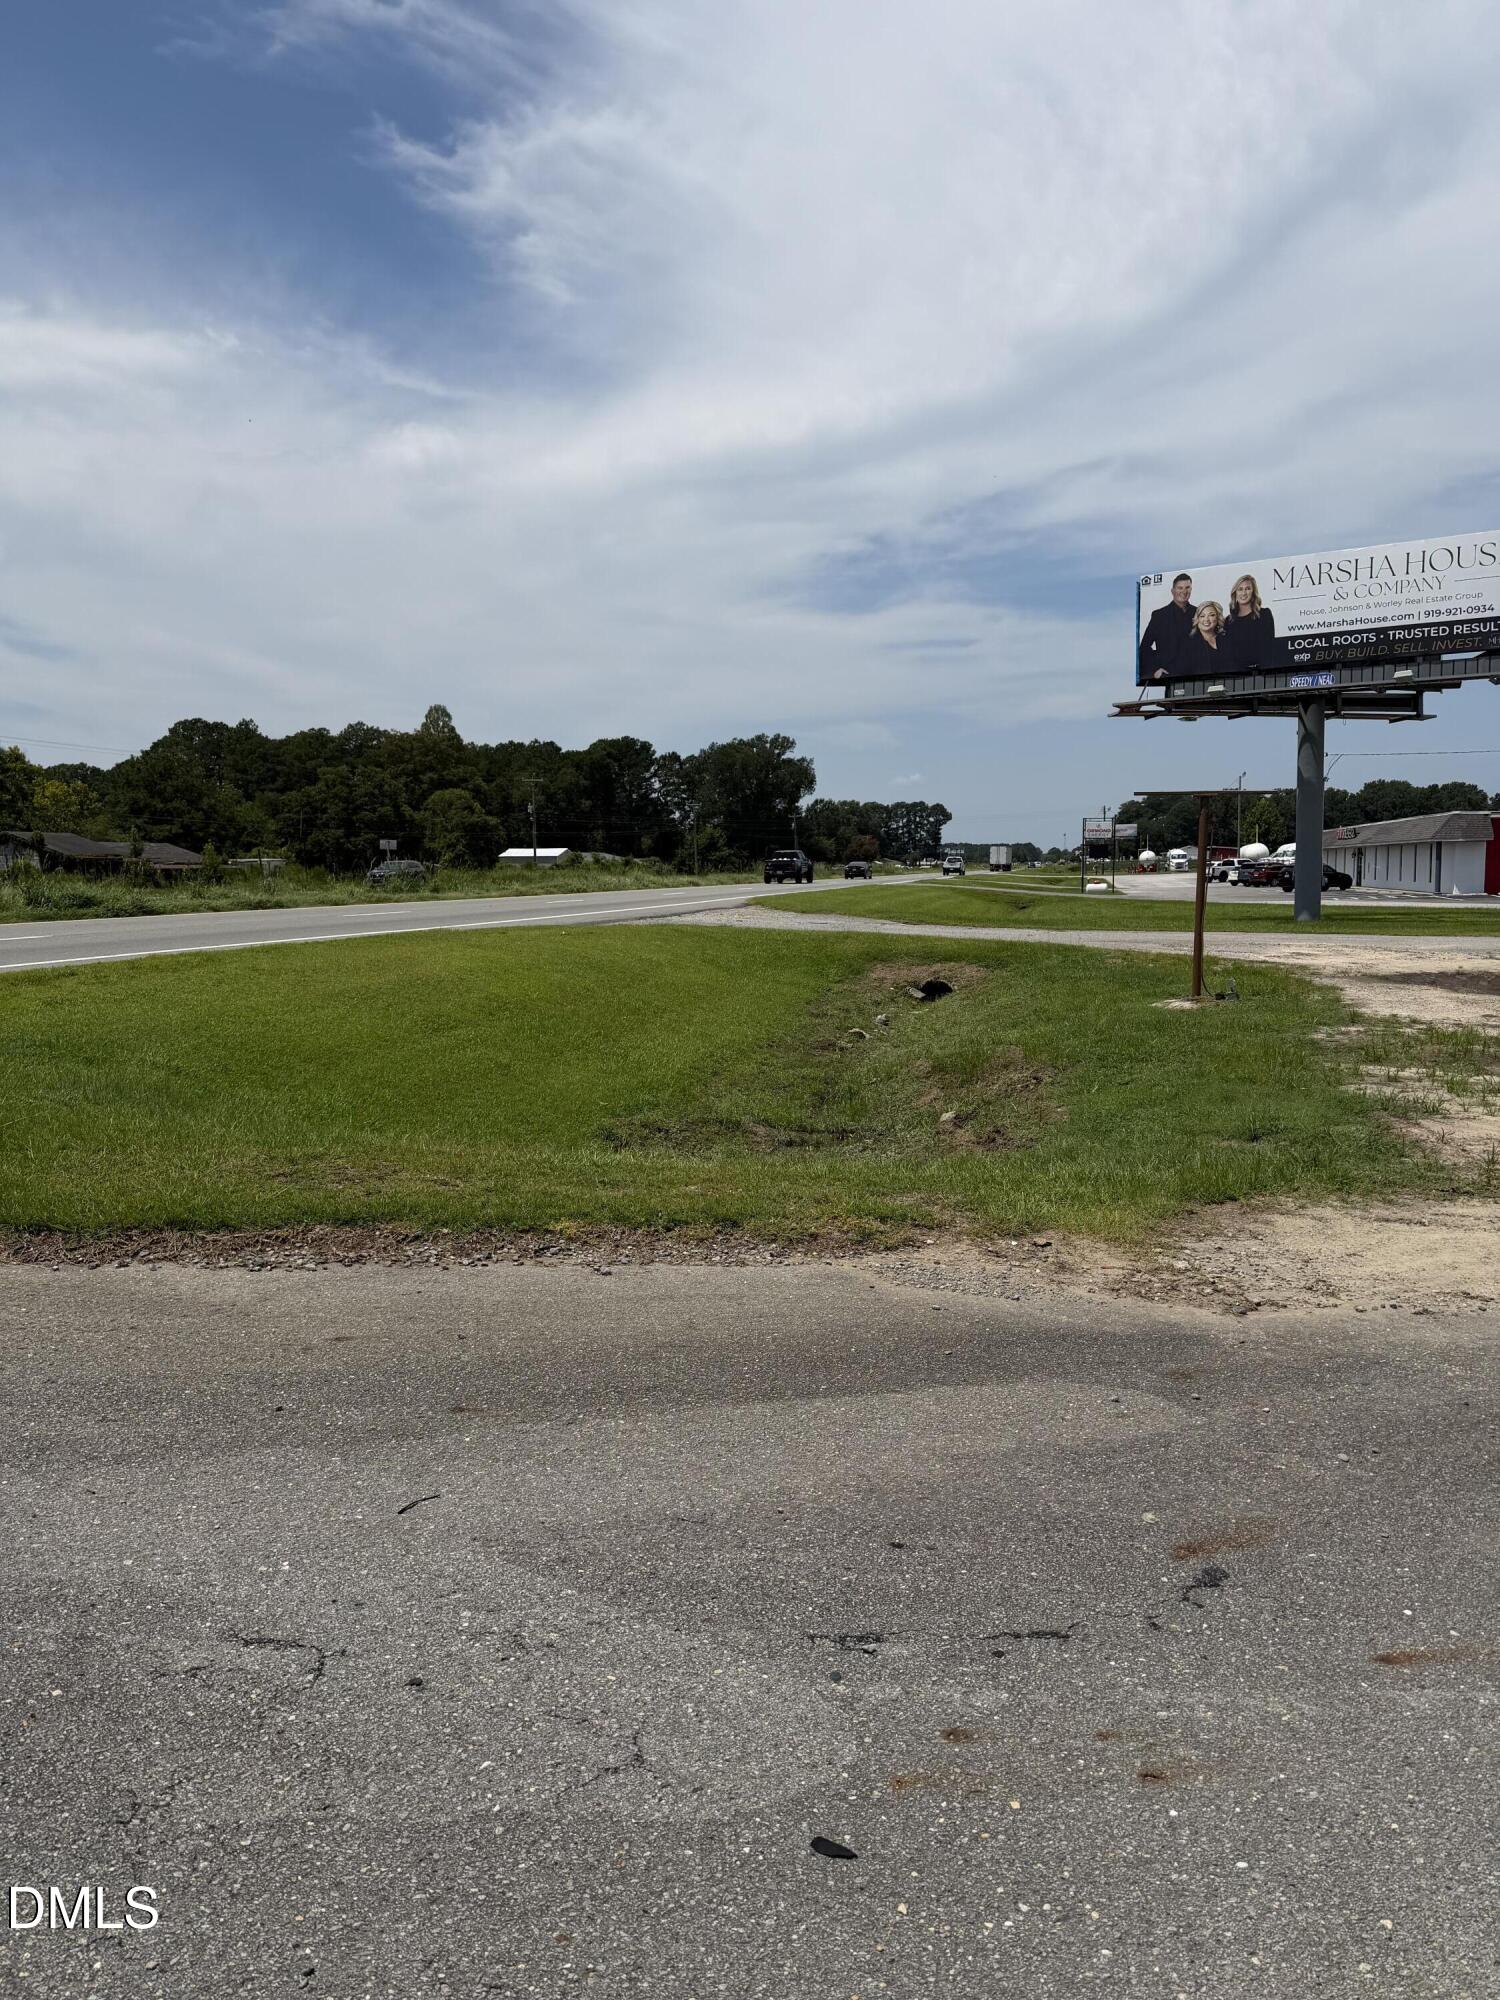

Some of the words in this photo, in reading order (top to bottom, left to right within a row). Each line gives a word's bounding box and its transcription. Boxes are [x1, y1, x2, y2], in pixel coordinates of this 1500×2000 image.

[1273, 555, 1396, 590] MARSHA
[1405, 542, 1500, 575] HOUS
[1333, 587, 1348, 601] &
[1354, 575, 1446, 599] COMPANY
[1299, 608, 1327, 616] House,
[1328, 604, 1364, 614] Johnson
[1373, 600, 1402, 609] Worley
[1405, 597, 1424, 605] Real
[1425, 594, 1453, 604] Estate
[1455, 592, 1484, 601] Group
[1288, 613, 1415, 632] www.MarshaHouse.com
[1288, 638, 1329, 650] LOCAL
[1332, 632, 1376, 646] ROOTS
[1387, 626, 1449, 640] TRUSTED
[1453, 621, 1500, 635] RESUL
[1315, 649, 1343, 661] BUY.
[1347, 645, 1390, 658] BUILD.
[1393, 641, 1428, 653] SELL.
[1432, 637, 1483, 651] INVEST.
[1290, 676, 1313, 688] SPEEDY
